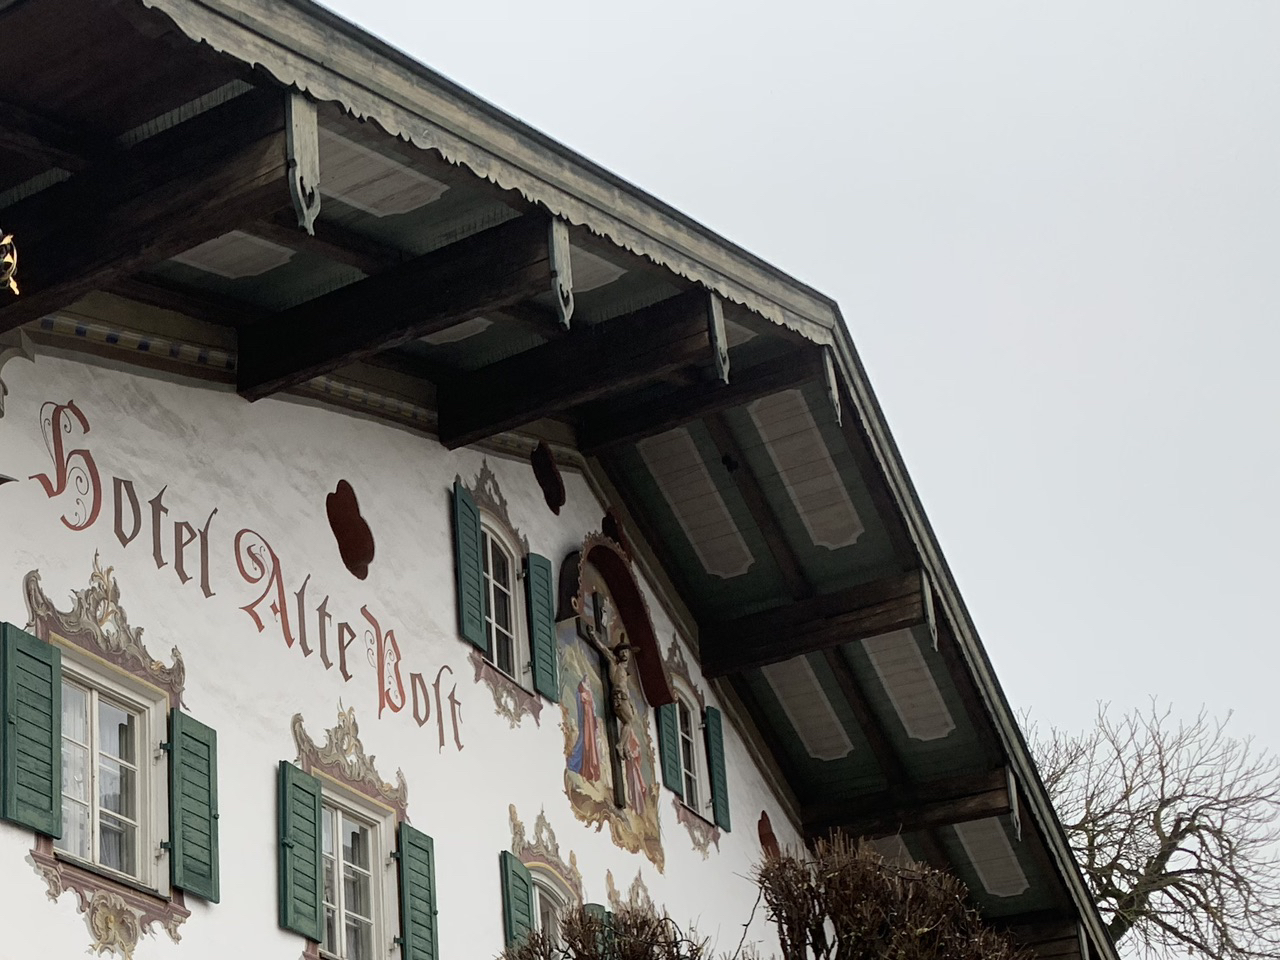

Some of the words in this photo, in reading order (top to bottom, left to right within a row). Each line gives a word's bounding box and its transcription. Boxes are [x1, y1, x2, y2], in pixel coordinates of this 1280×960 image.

[28, 399, 218, 599] Hotel
[234, 528, 357, 683] Alte
[360, 604, 464, 754] Post
